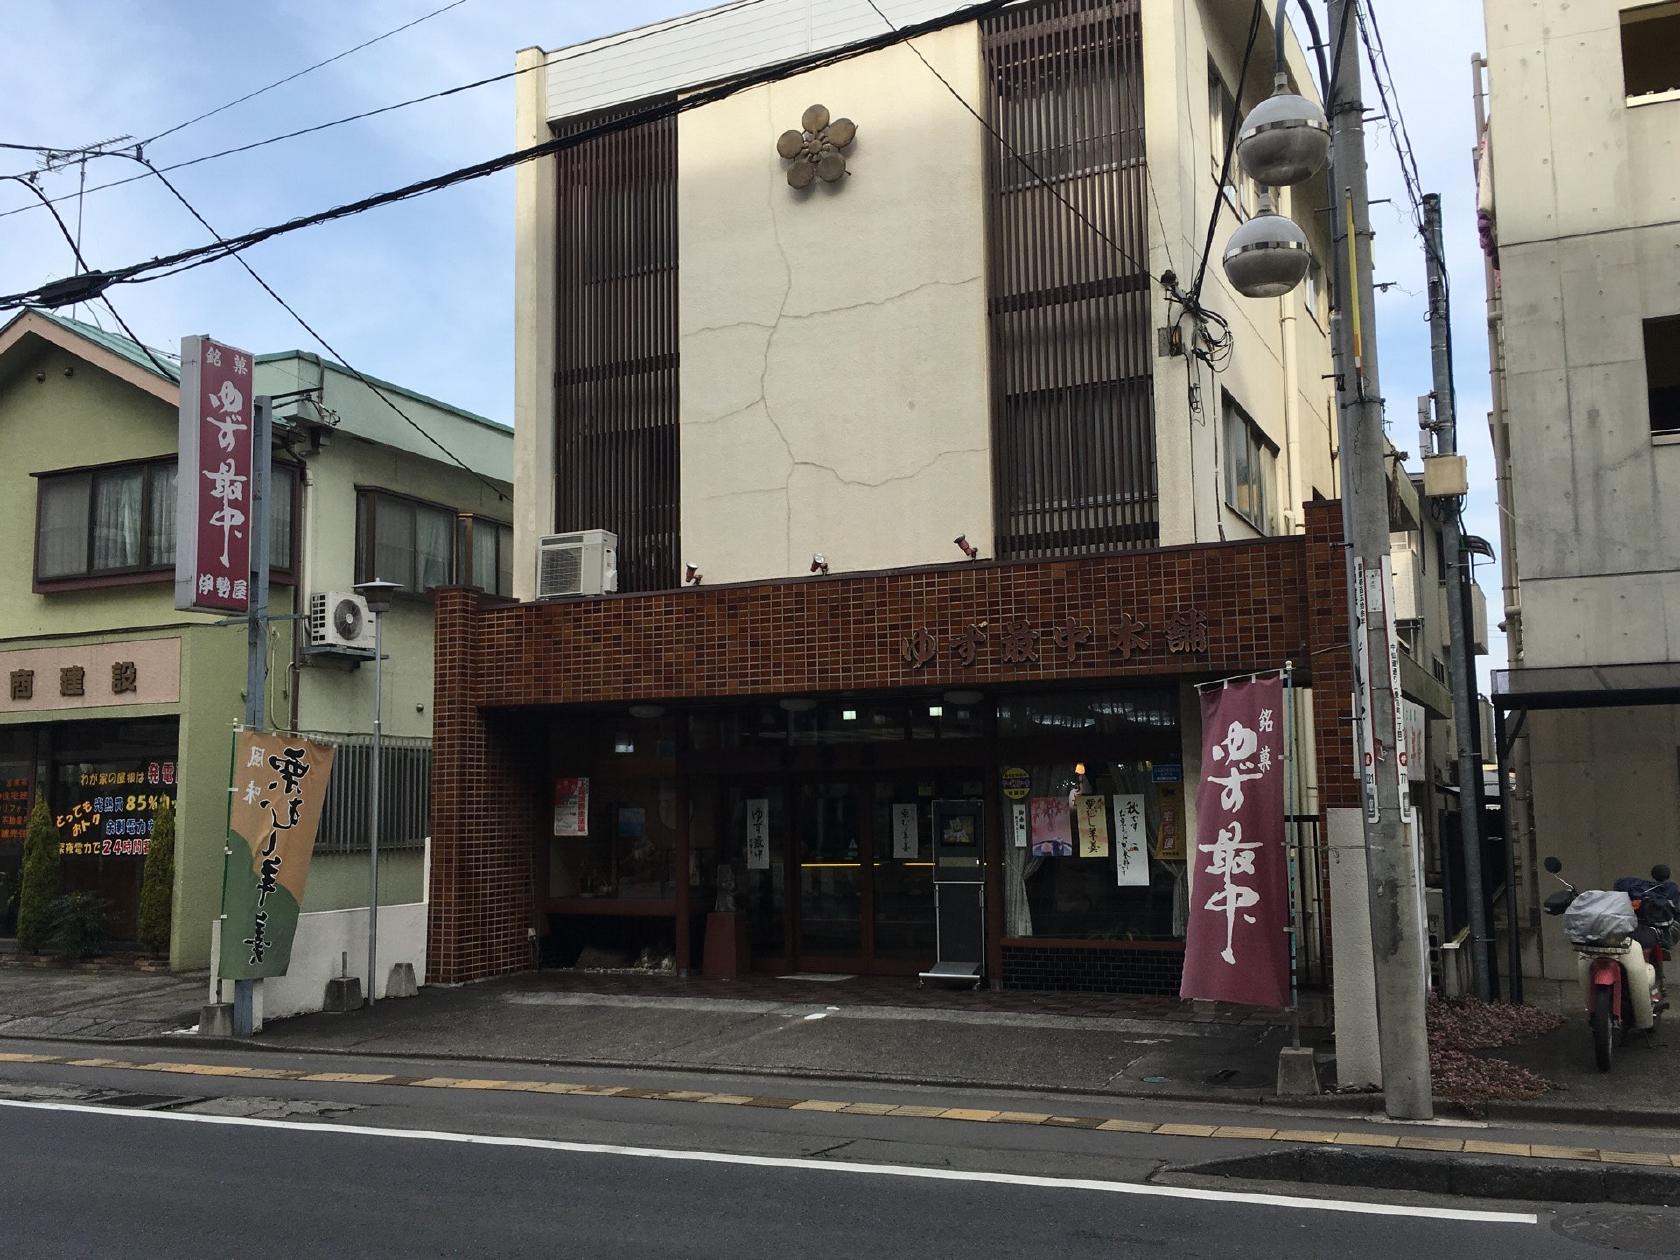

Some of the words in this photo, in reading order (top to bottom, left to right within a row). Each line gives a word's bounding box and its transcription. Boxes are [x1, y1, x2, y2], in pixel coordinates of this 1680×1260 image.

[205, 345, 249, 376] 銘菓
[202, 380, 248, 569] ゆず最中
[198, 573, 248, 600] 伊勢屋
[901, 607, 1209, 669] ゆず最中本舗
[55, 800, 93, 829] とっても
[1198, 720, 1263, 966] ゆず最中
